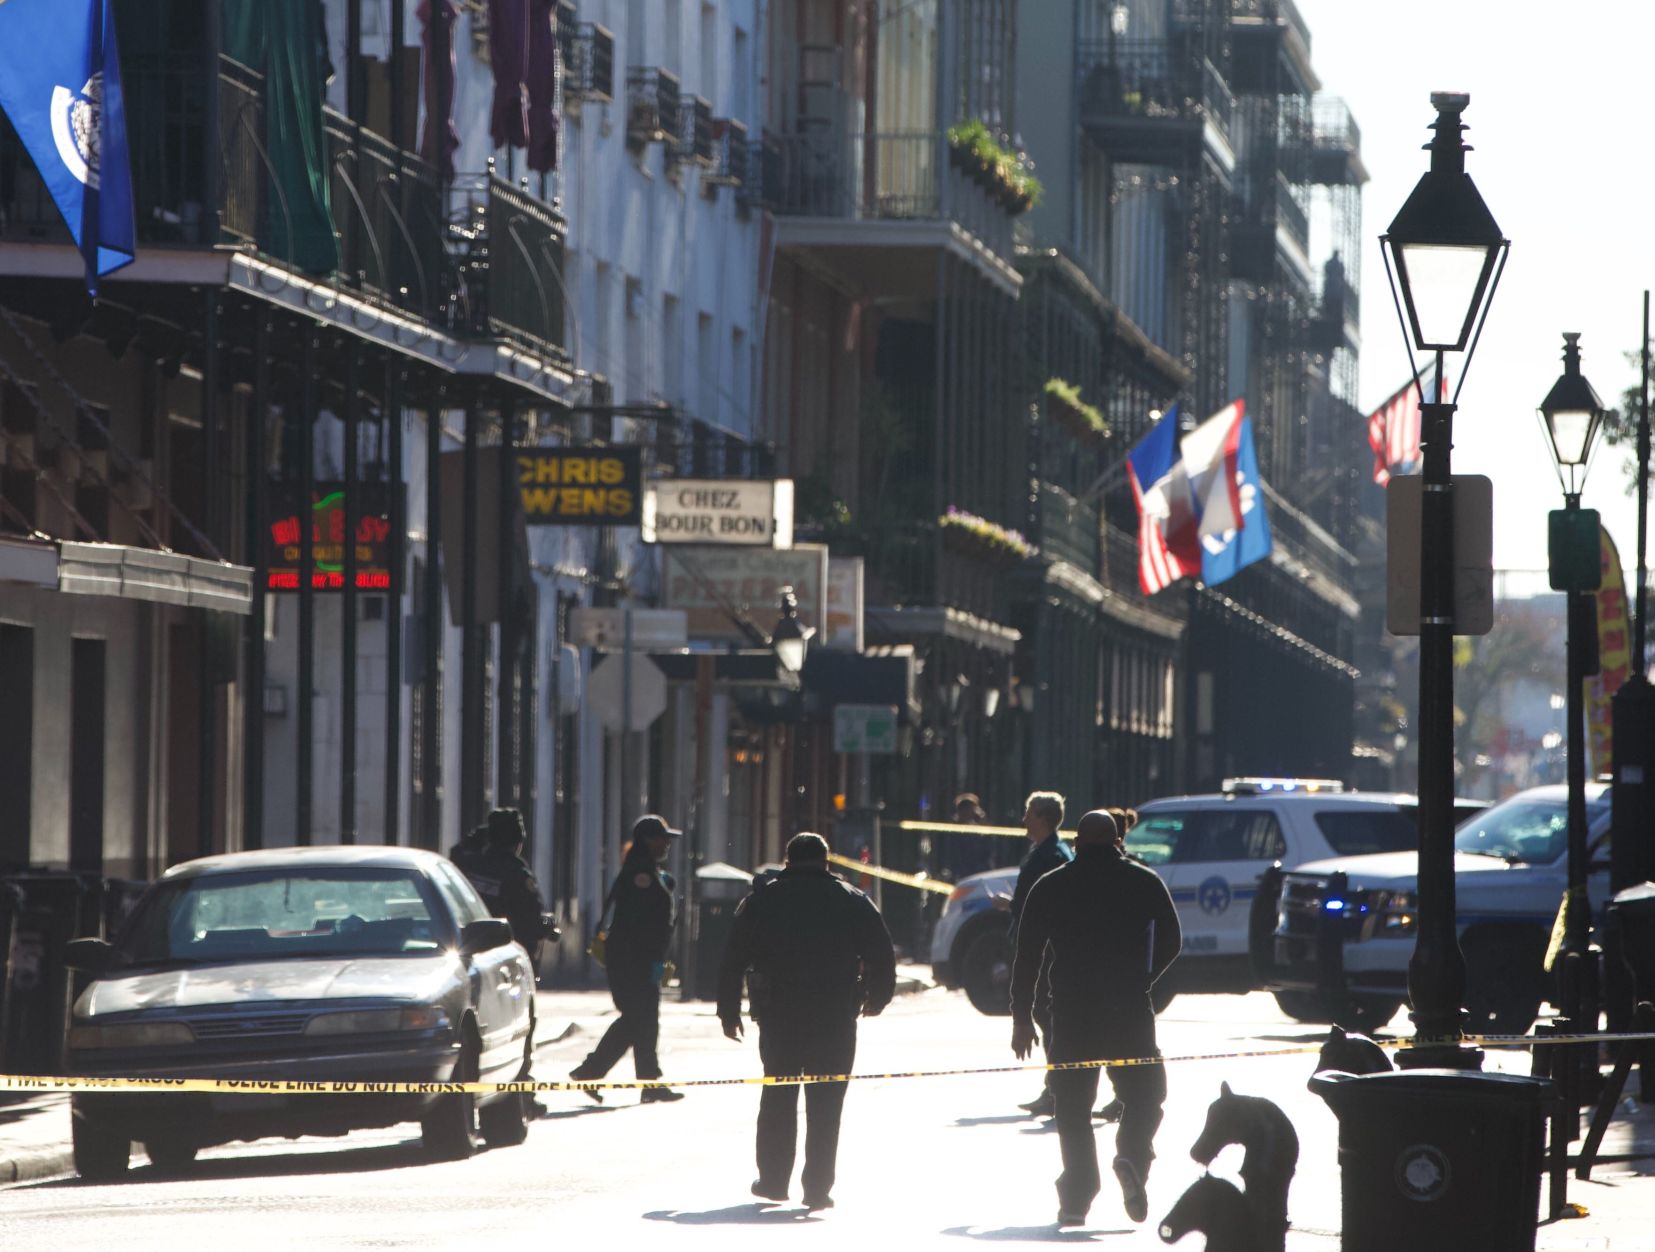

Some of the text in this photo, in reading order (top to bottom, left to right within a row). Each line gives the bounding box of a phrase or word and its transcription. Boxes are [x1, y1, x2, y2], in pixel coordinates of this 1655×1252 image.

[521, 488, 634, 516] WENS
[678, 487, 742, 509] CHEZ
[655, 512, 767, 537] BOUR BON
